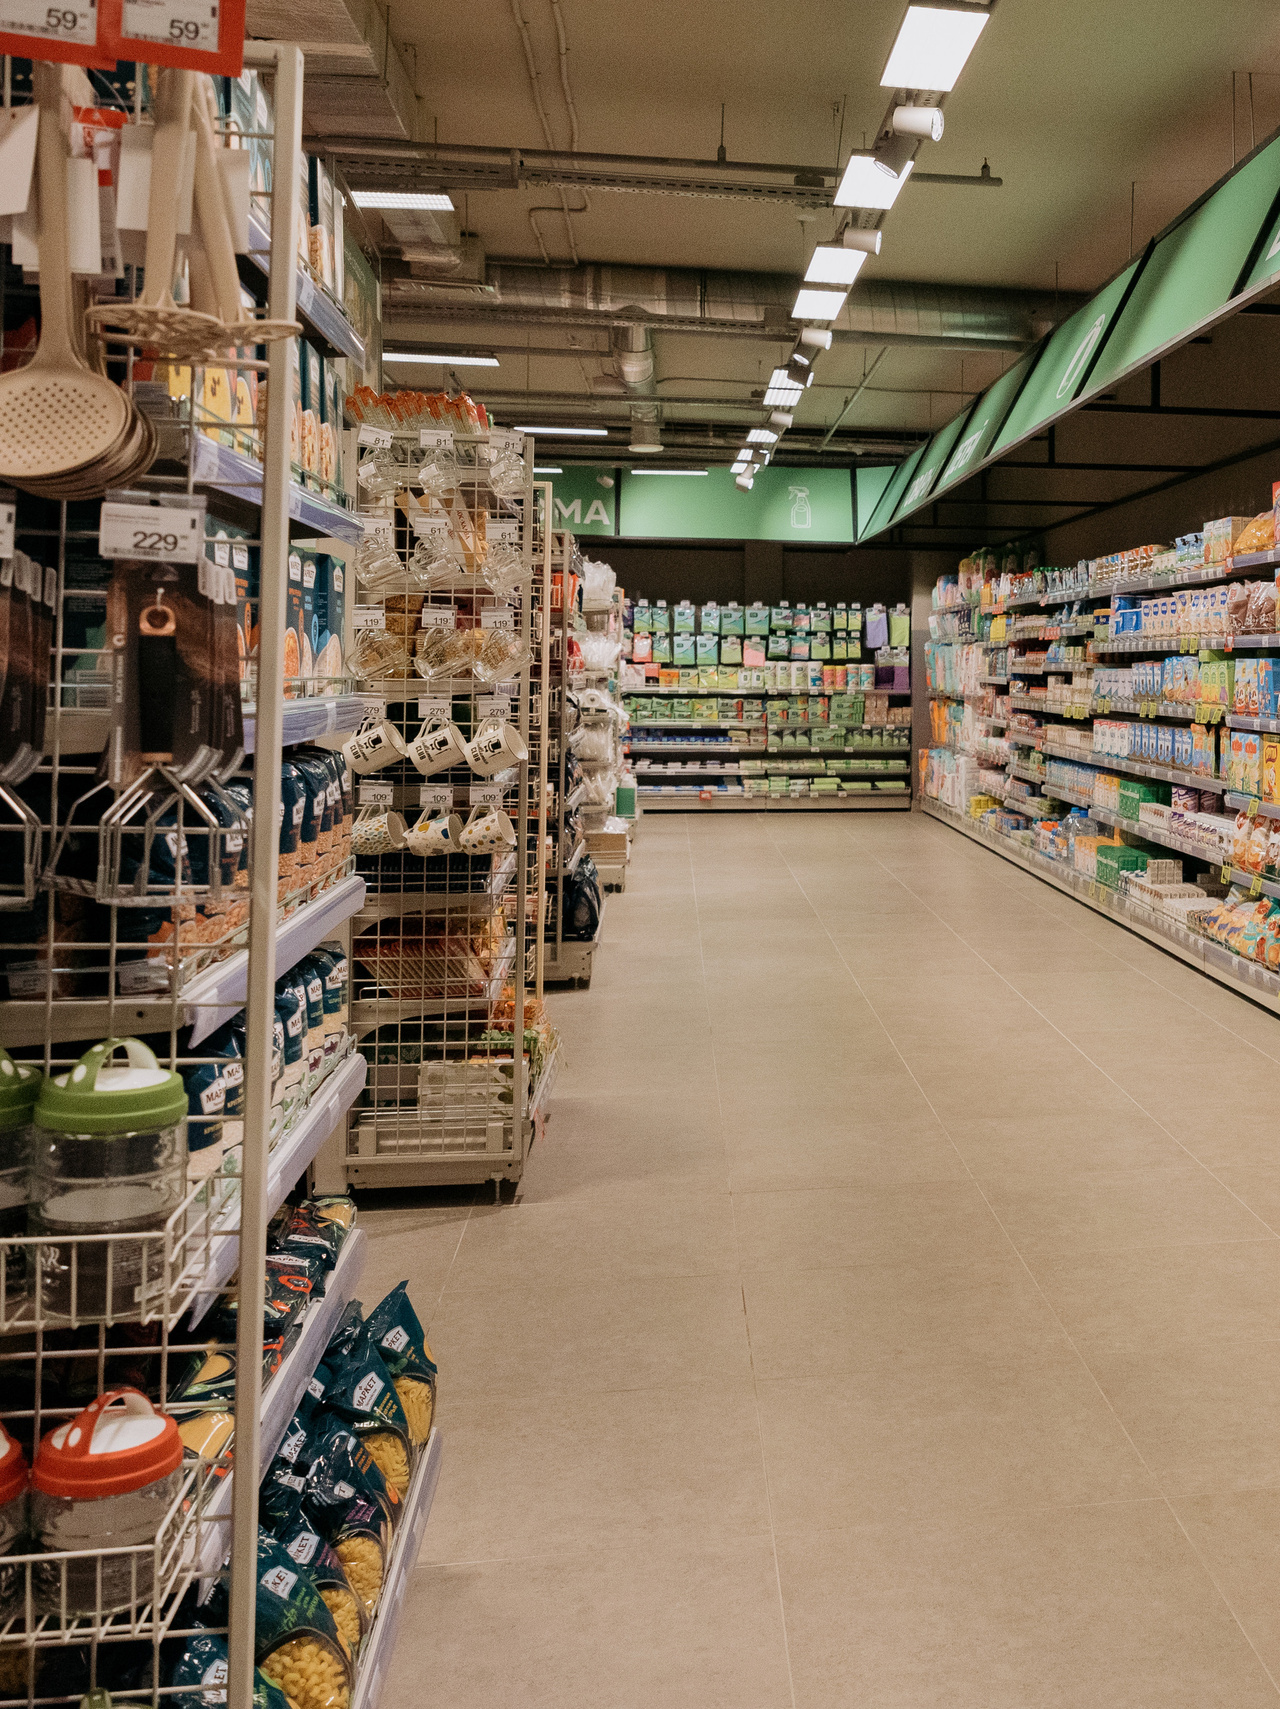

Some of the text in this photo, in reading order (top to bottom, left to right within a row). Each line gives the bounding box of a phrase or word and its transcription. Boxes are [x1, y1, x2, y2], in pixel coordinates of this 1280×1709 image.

[46, 9, 77, 30] 59
[169, 19, 199, 40] 59
[133, 532, 178, 550] 229
[357, 1376, 376, 1407] МАРКЕТ
